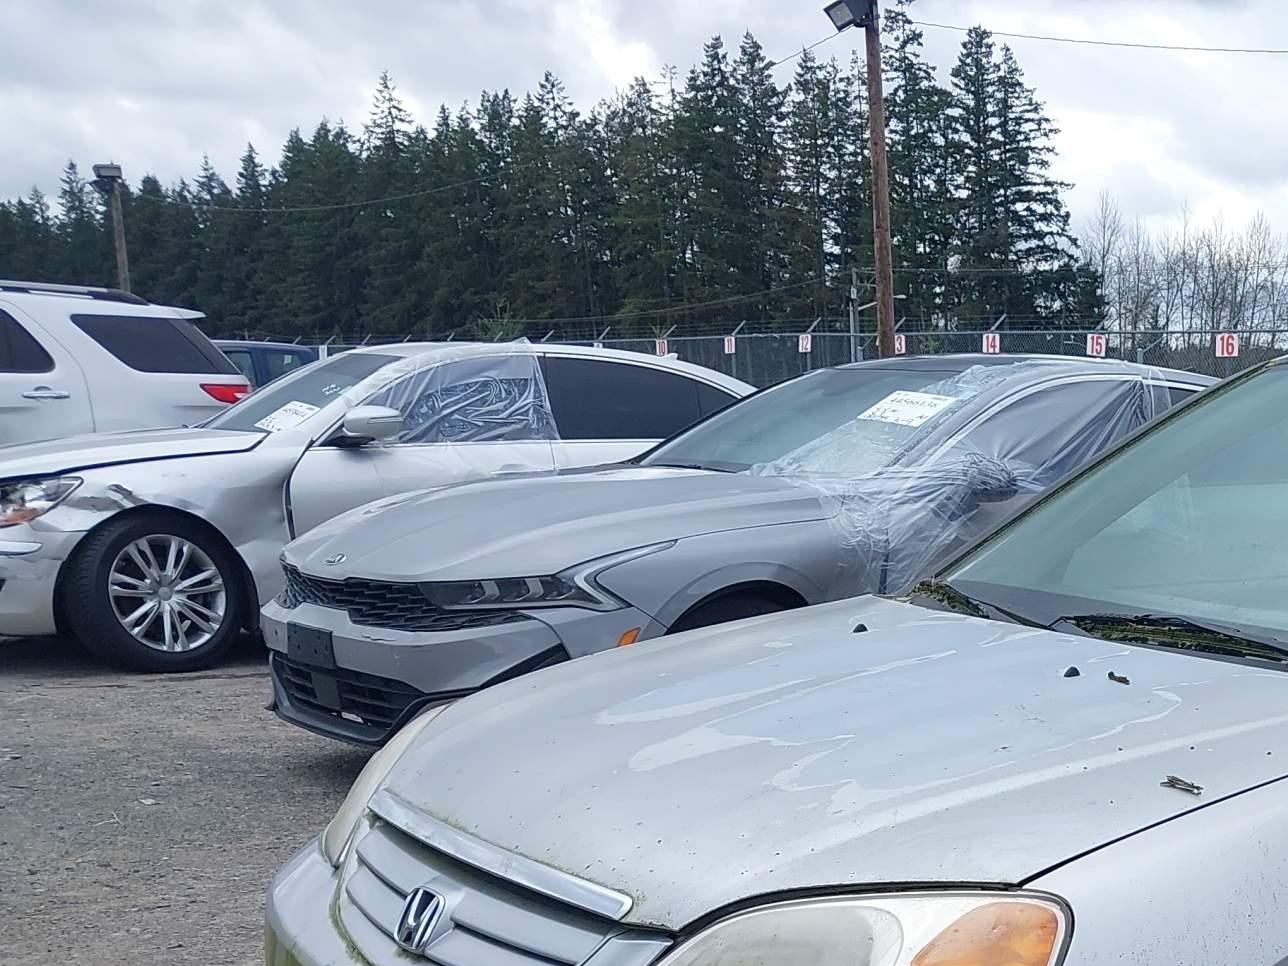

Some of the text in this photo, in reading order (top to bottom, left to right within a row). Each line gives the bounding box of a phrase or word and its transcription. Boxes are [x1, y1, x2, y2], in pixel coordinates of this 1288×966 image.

[801, 335, 809, 351] 12
[986, 335, 997, 352] 14
[1090, 336, 1103, 355] 15
[1220, 335, 1235, 356] 16
